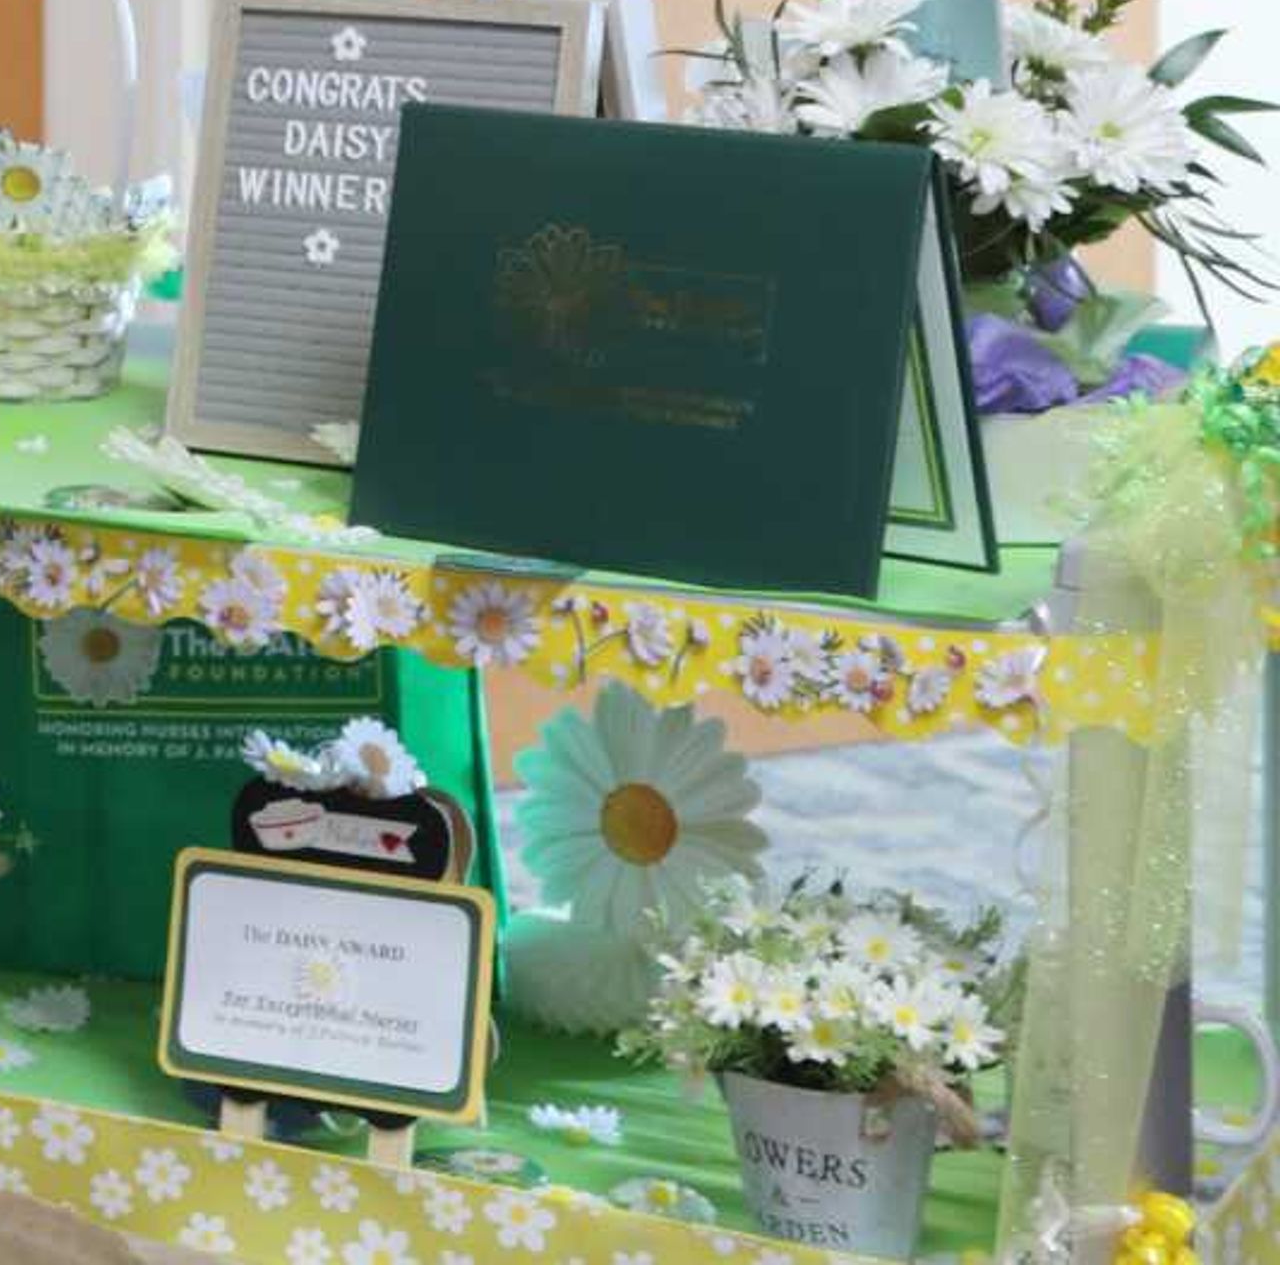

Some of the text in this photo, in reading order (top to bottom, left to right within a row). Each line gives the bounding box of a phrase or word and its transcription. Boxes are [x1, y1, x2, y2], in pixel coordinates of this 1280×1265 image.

[247, 66, 427, 111] CONGRATS
[283, 119, 393, 162] DAISY
[169, 664, 361, 682] FOUNDATION
[38, 721, 137, 738] HONORING
[141, 723, 211, 740] NURSES
[80, 741, 159, 758] MEMORY
[164, 743, 189, 759] OF
[275, 928, 331, 951] DAISY
[336, 937, 407, 962] AWARD
